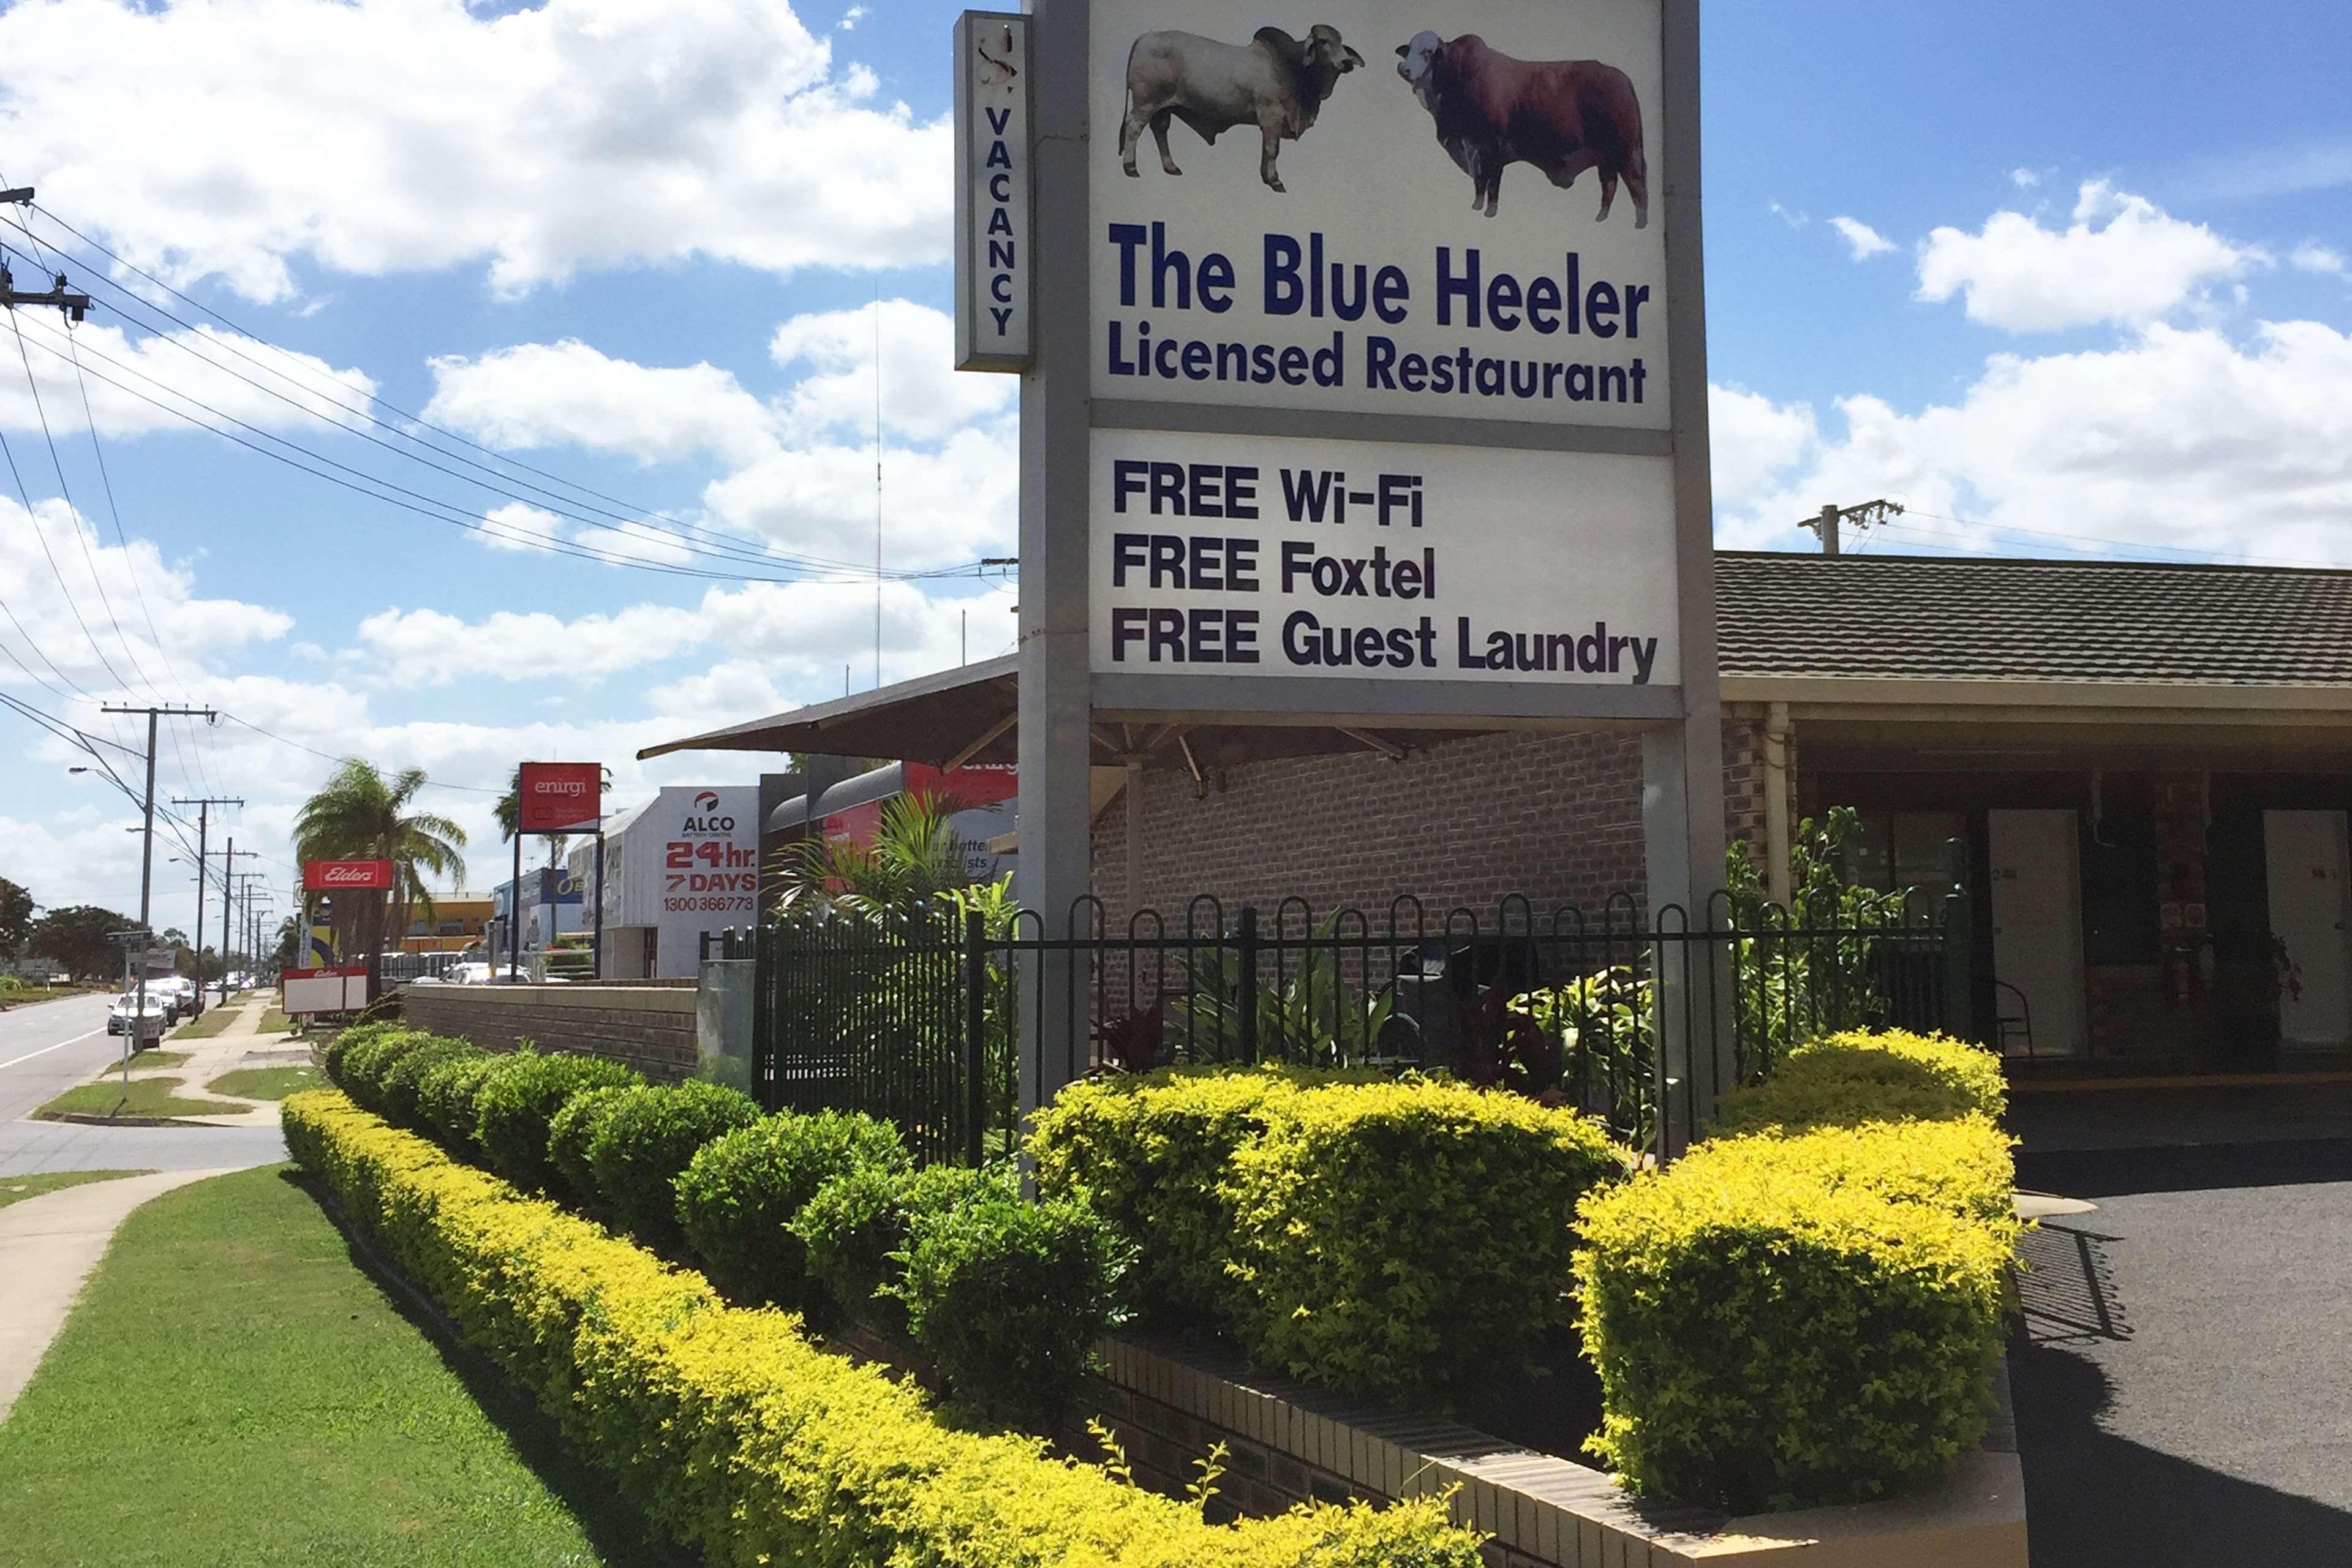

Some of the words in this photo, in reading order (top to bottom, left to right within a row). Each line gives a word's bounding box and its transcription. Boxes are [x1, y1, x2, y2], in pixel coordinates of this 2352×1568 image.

[986, 107, 1016, 336] VACANCY
[1109, 221, 1235, 314] The
[1263, 232, 1410, 323] Blue
[1435, 246, 1649, 338] Heeler
[1109, 320, 1344, 387] Licensed
[1366, 335, 1646, 404] Restaurant
[1113, 460, 1259, 519] FREE
[1279, 469, 1423, 527] Wi-Fi
[1112, 533, 1259, 592] FREE
[1281, 541, 1435, 599] Foxtel
[1112, 608, 1259, 663] FREE
[1282, 609, 1437, 668] Guest
[1458, 616, 1658, 685] Laundry
[535, 777, 587, 797] enirgi
[683, 817, 735, 832] ALCO
[324, 867, 374, 881] Elders
[666, 842, 724, 869] 24
[726, 842, 756, 868] hr.
[664, 897, 698, 911] 1300
[699, 896, 754, 911] 366773
[666, 873, 687, 892] 7
[690, 873, 757, 892] DAYS
